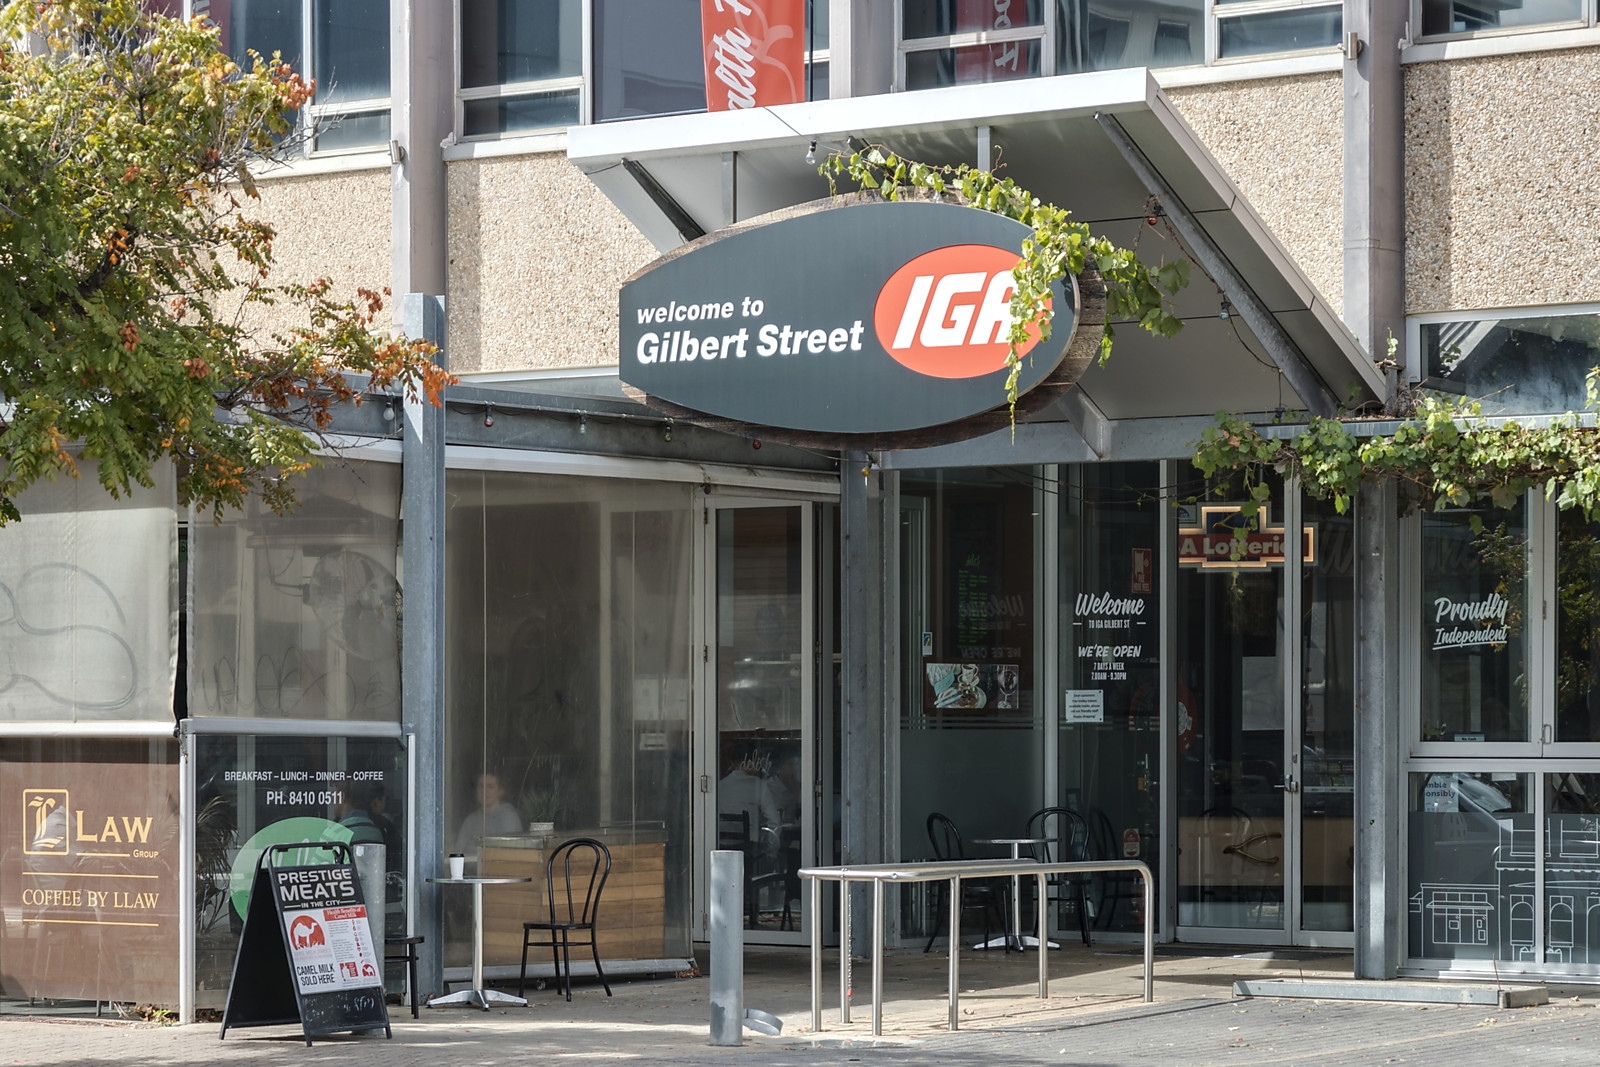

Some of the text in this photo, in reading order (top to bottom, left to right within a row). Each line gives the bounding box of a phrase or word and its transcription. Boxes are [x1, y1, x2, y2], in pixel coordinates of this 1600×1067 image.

[637, 296, 765, 325] welcome to
[636, 320, 865, 365] Gilbert Street
[1178, 537, 1198, 555] A
[1075, 591, 1146, 616] Welcome
[1434, 592, 1509, 625] Proudly
[1088, 619, 1095, 629] TO
[1104, 619, 1123, 629] GILBERT
[1123, 619, 1130, 629] ST
[1433, 624, 1511, 648] Independent
[1078, 643, 1142, 658] WE'RE OPEN
[224, 771, 273, 781] BREAKFAST
[280, 771, 308, 781] LUNCH
[315, 771, 345, 781] DINNER
[352, 771, 384, 781] COFFEE
[266, 791, 343, 805] PH. 8410 0511
[277, 868, 353, 885] PRESTIGE
[22, 888, 160, 910] COFFEE BY LLAW
[279, 880, 356, 902] MEATS
[325, 899, 341, 907] CITY
[296, 963, 336, 977] CAMEL MILK
[300, 975, 318, 986] SOLD
[318, 974, 336, 984] HERE
